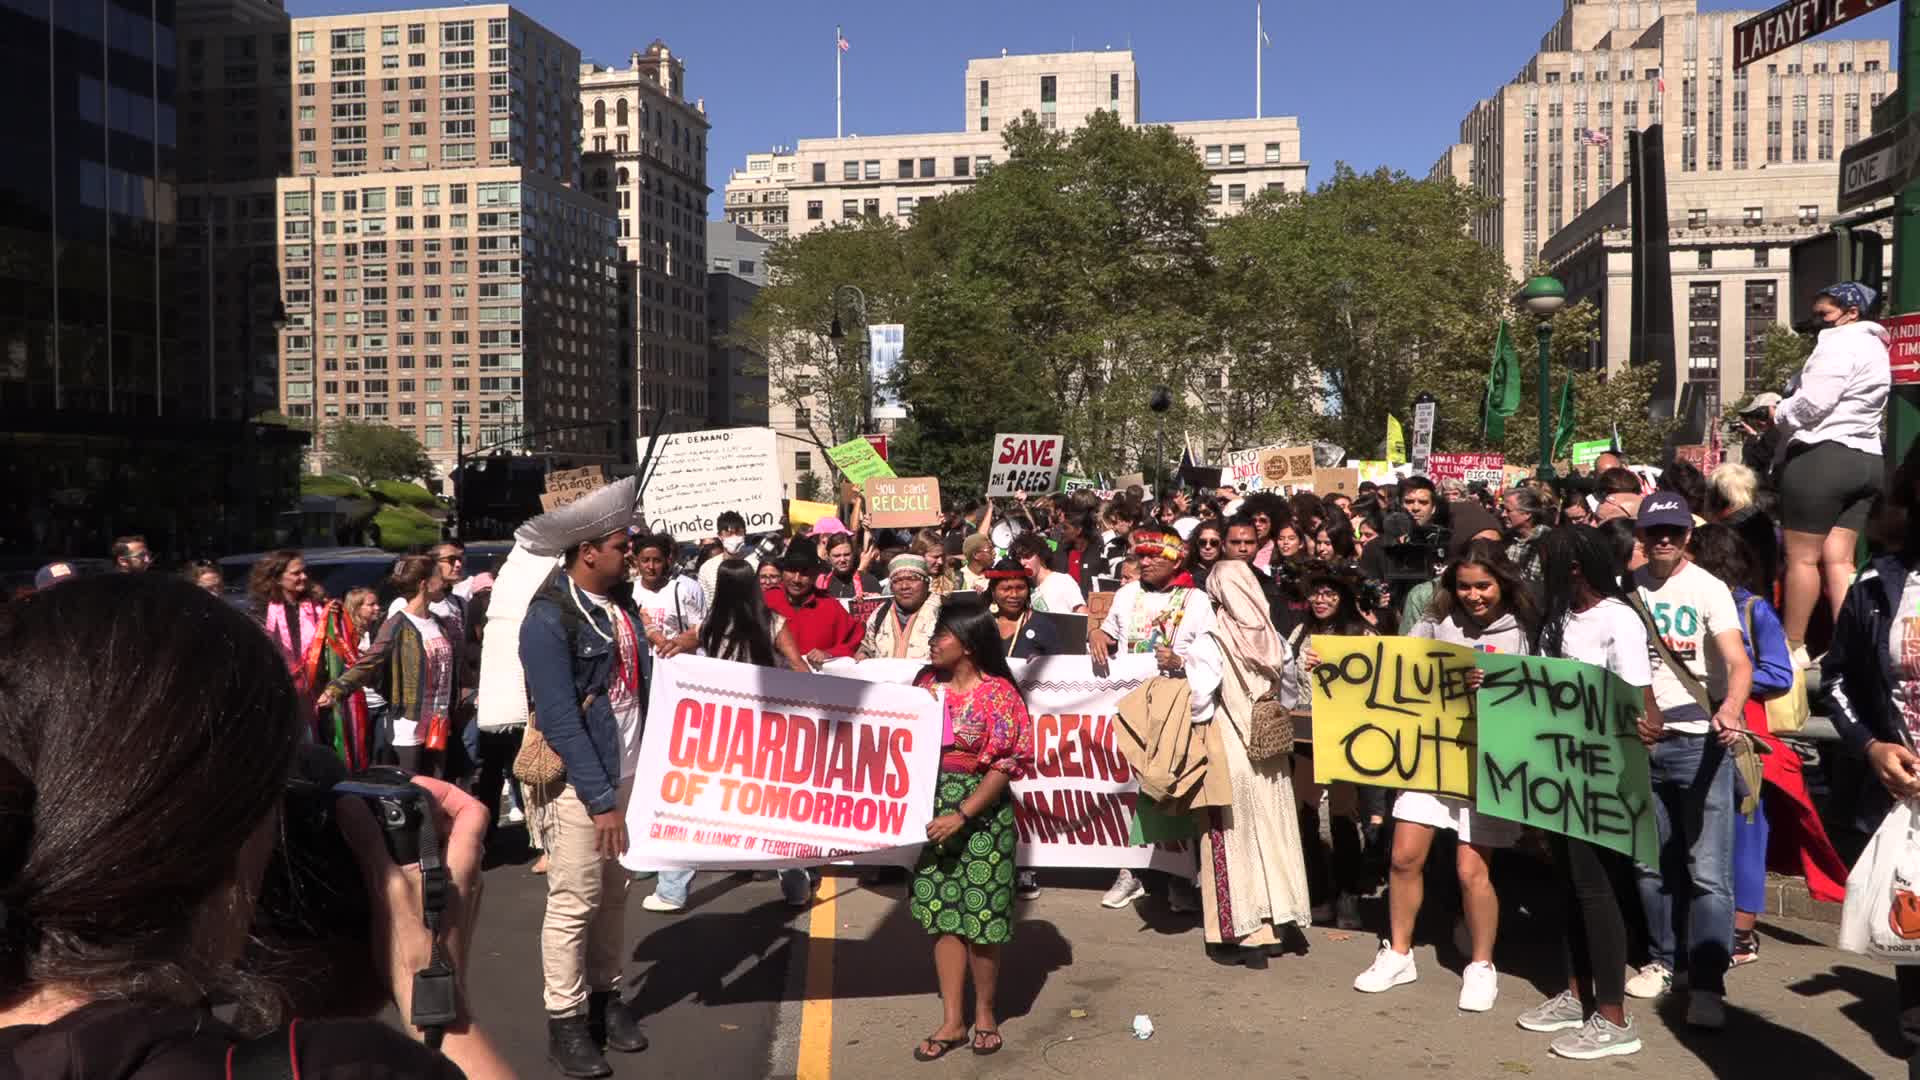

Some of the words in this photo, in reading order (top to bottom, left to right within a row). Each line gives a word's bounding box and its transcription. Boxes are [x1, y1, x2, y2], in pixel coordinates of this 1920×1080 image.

[1848, 154, 1879, 189] ONE
[998, 437, 1055, 467] SAVE
[1428, 455, 1458, 466] NIMAL
[1007, 470, 1051, 492] TREES
[1466, 470, 1485, 479] BIG
[1486, 470, 1501, 480] OIL
[649, 514, 713, 535] Climate
[1647, 602, 1697, 636] 50
[1313, 642, 1476, 718] POLLUTE
[1484, 660, 1610, 735] SHOW
[668, 698, 914, 799] GUARDIANS
[1340, 717, 1476, 793] OUT
[1536, 733, 1614, 776] THE
[660, 770, 709, 807] OF
[720, 778, 908, 836] TOMORROW
[1485, 752, 1647, 861] MONEY
[650, 823, 689, 840] GLOBAL
[692, 830, 742, 849] ALLIANCE
[744, 837, 756, 850] OF
[761, 838, 822, 859] TERRITORIAL
